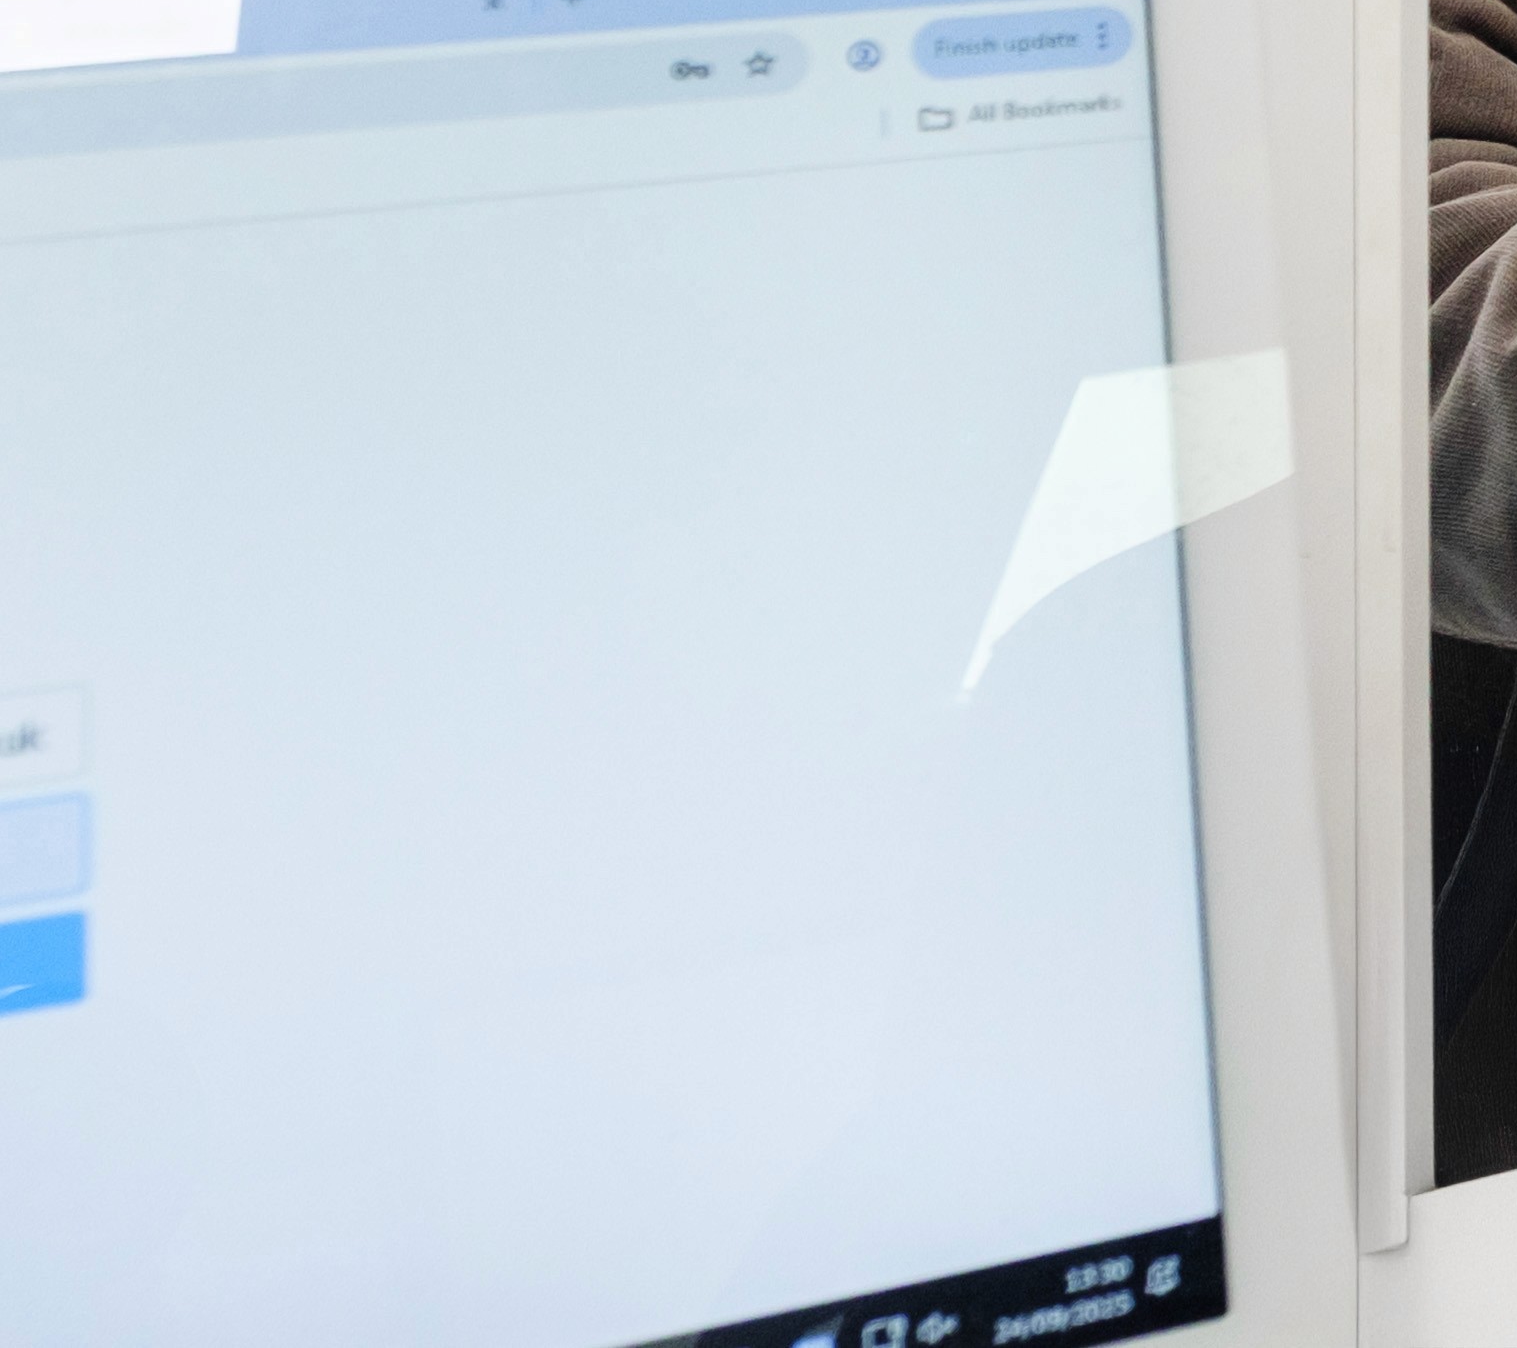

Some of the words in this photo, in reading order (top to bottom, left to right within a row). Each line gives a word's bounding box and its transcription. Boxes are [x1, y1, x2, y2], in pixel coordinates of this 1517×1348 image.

[934, 36, 997, 56] Finish
[1003, 33, 1079, 56] update
[1003, 95, 1122, 120] Bookmarks
